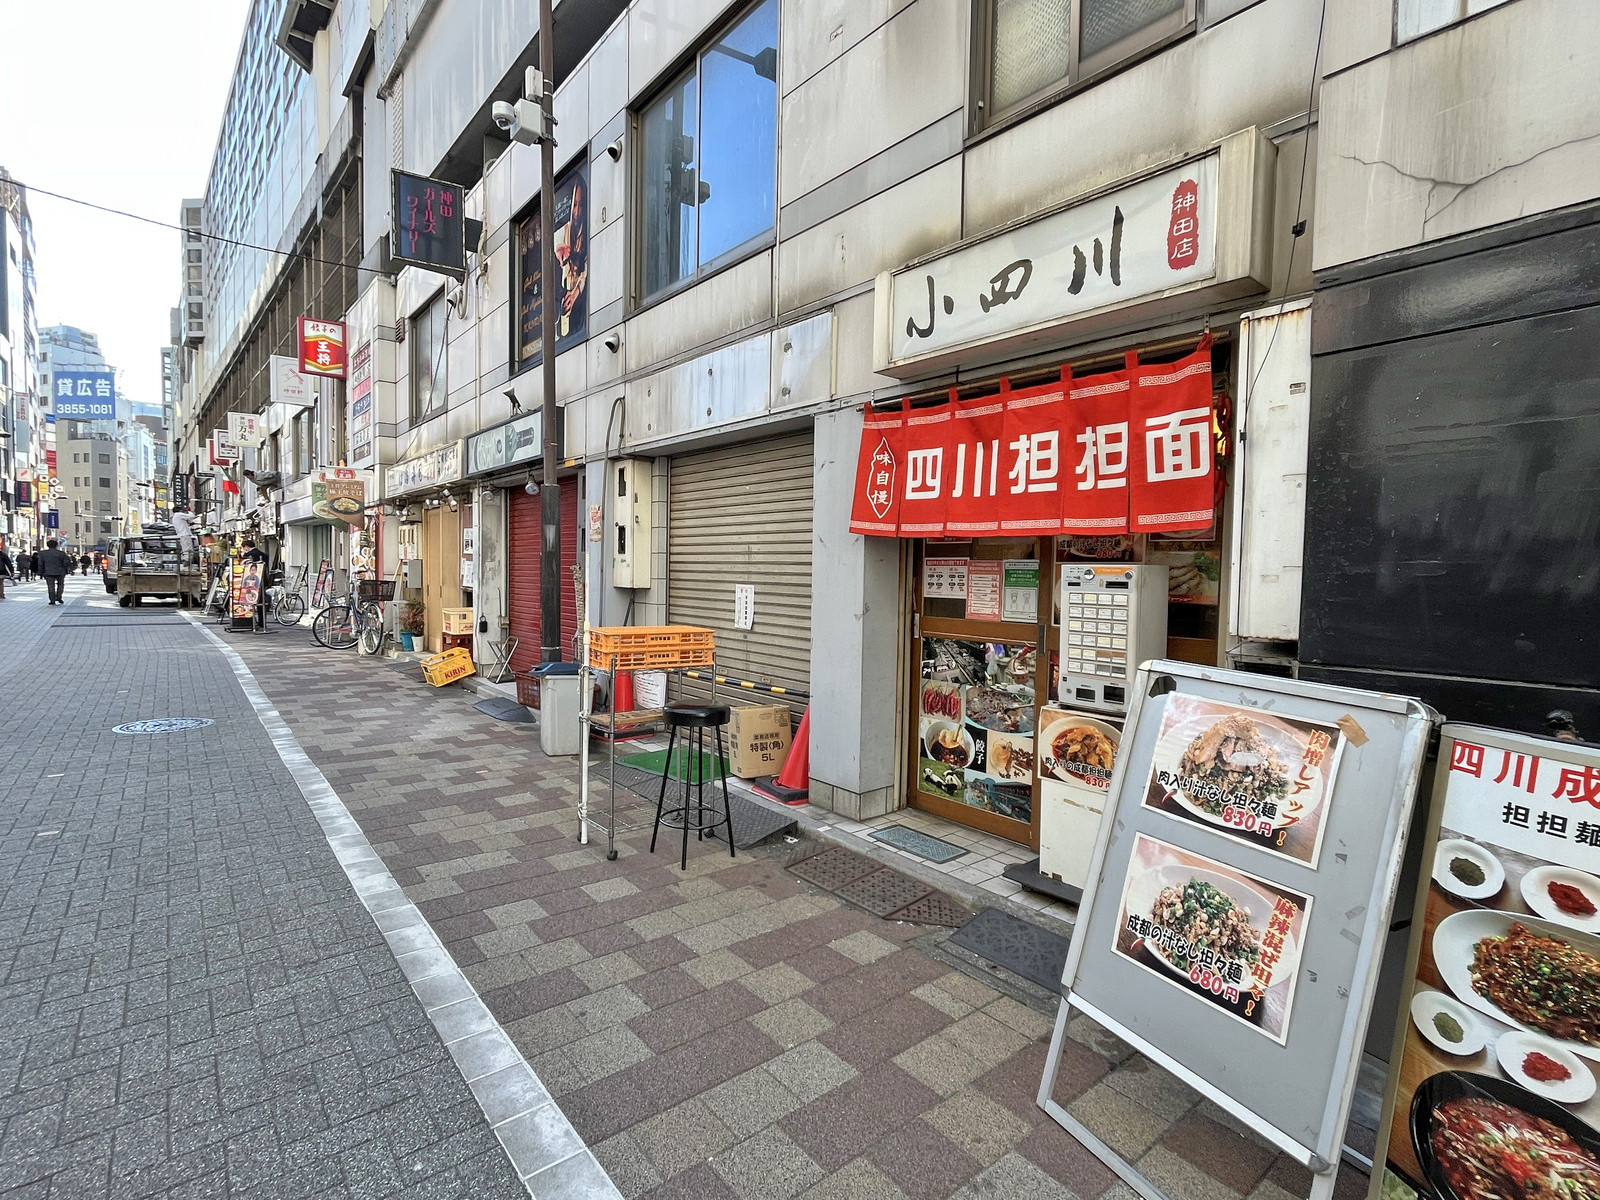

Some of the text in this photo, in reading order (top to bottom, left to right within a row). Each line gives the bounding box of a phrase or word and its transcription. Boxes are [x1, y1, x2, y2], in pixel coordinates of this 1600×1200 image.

[423, 186, 437, 236] ガールズ
[439, 189, 454, 218] 神田
[406, 195, 419, 254] ワイナリー
[1170, 190, 1196, 261] 神田店
[906, 205, 1124, 339] 小四川
[310, 322, 337, 334] 餃子の
[316, 340, 331, 366] 王将
[56, 378, 113, 398] 貸広告
[56, 403, 113, 415] 3855-1081
[905, 406, 1212, 501] 四川担担面
[871, 450, 894, 506] 味自慢
[444, 665, 466, 680] KIRIN
[761, 752, 776, 762] 5L
[974, 738, 986, 765] 餃子
[1222, 806, 1274, 838] 830円
[1188, 965, 1241, 1005] 680円
